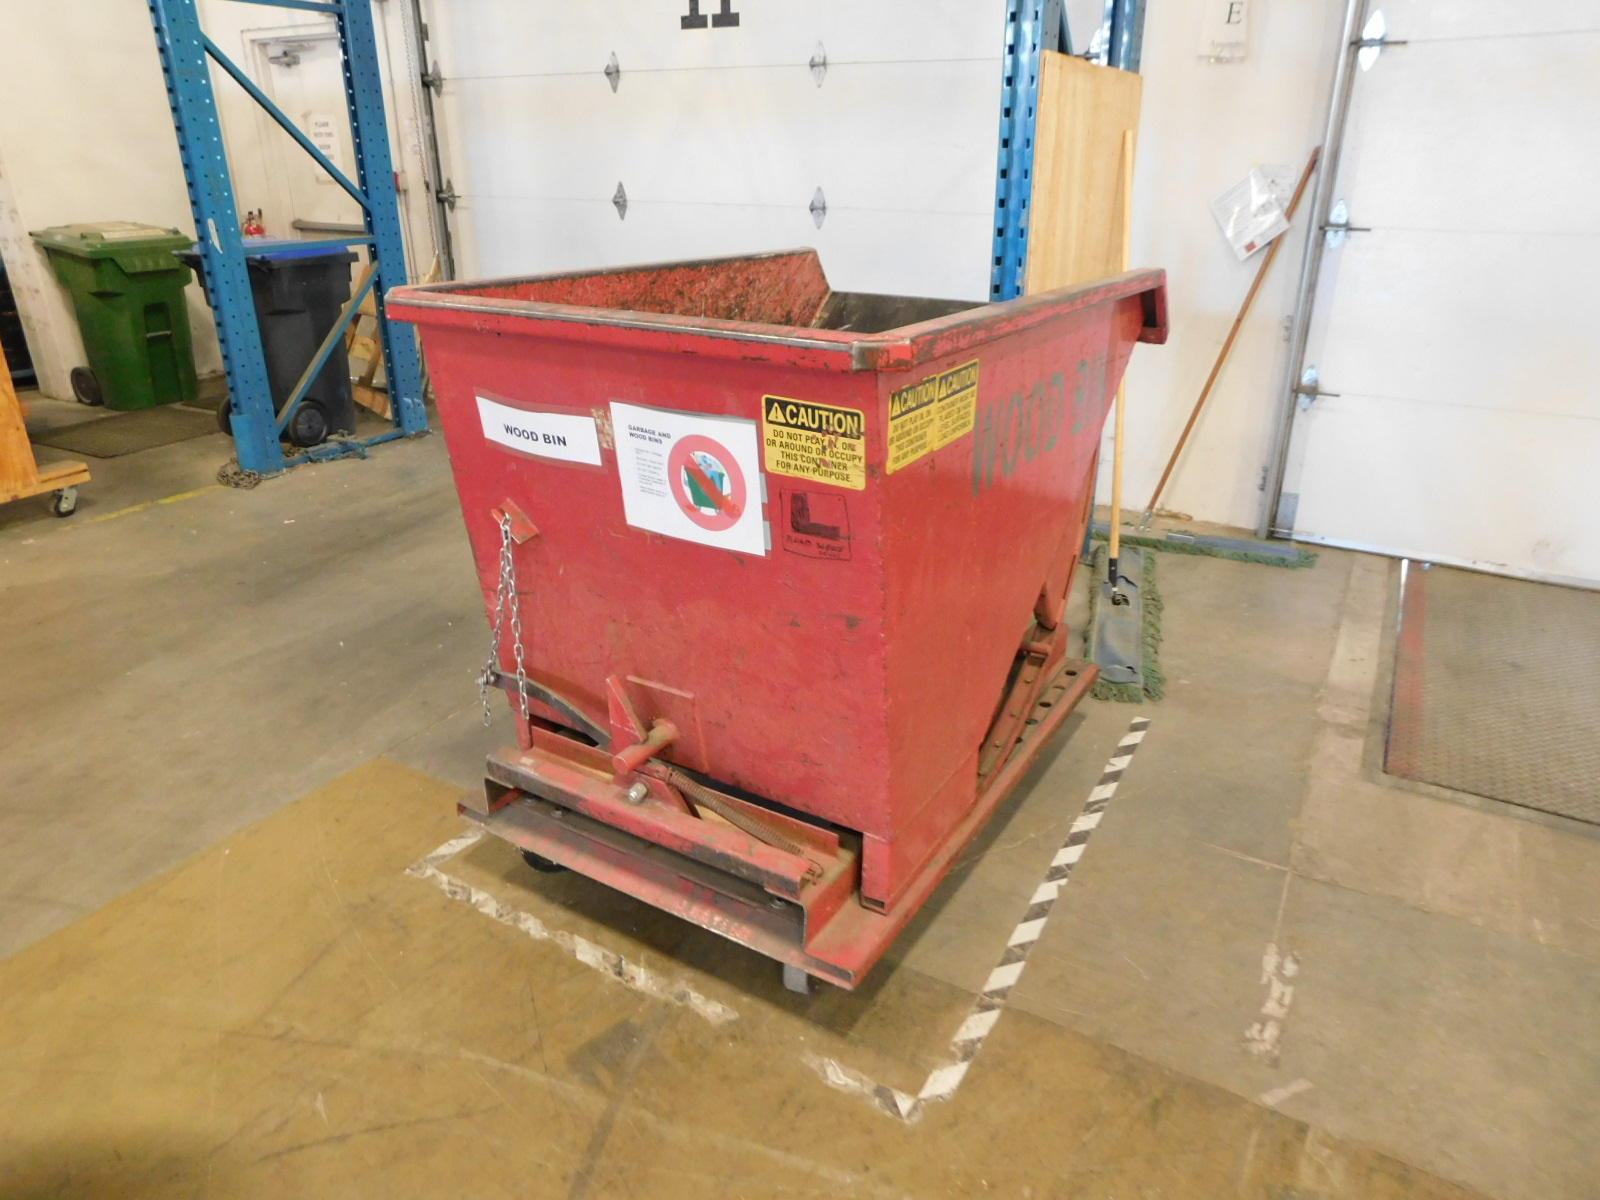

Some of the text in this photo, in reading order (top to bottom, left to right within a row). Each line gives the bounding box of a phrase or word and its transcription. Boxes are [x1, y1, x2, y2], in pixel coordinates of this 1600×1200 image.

[1225, 1, 1243, 25] E
[948, 365, 977, 395] CAUTION
[901, 380, 935, 412] CAUTION
[628, 424, 671, 439] GARBAGE AND
[785, 404, 858, 436] CAUTION
[503, 423, 567, 447] WOOD BIN
[629, 432, 663, 445] WOOD BINS
[773, 429, 784, 438] DO
[787, 431, 802, 441] NOT
[806, 435, 825, 446] PLAY
[972, 370, 1064, 499] WOOD
[766, 438, 862, 464] OR AROUND OR OCCUPY
[781, 451, 848, 471] THIS CONTNER
[776, 460, 791, 470] FOR
[794, 463, 810, 473] ANY
[812, 467, 853, 483] PURPOSE.
